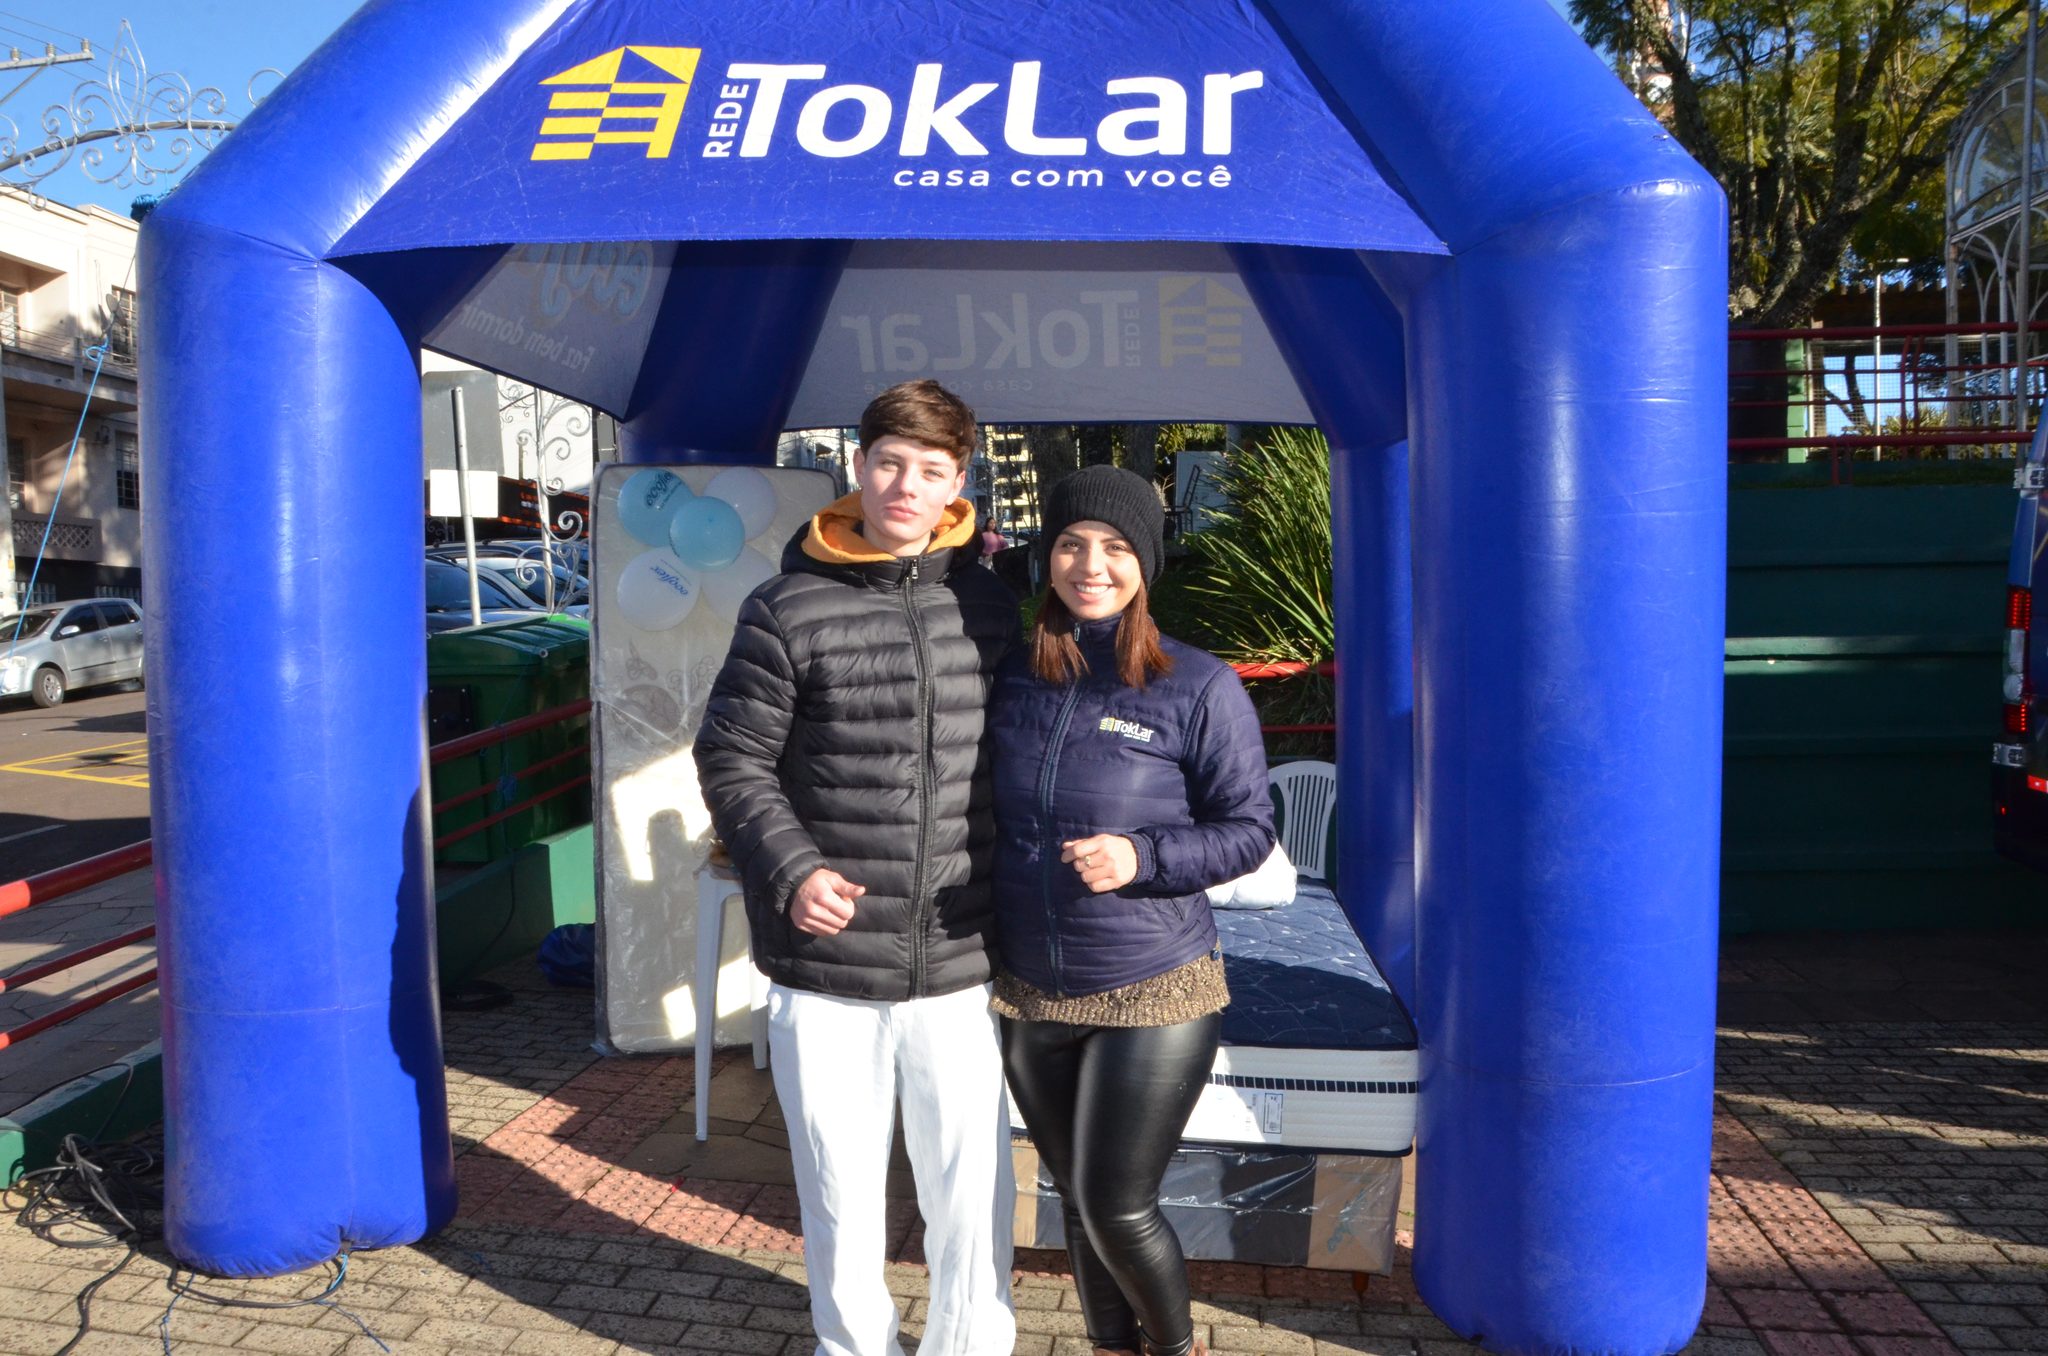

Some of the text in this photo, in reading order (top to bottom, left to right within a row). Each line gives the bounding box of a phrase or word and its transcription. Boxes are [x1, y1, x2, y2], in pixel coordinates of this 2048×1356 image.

[704, 83, 749, 158] REDE
[727, 60, 1264, 158] TokLar
[893, 163, 1233, 188] casa com você
[1115, 719, 1154, 739] TokLar
